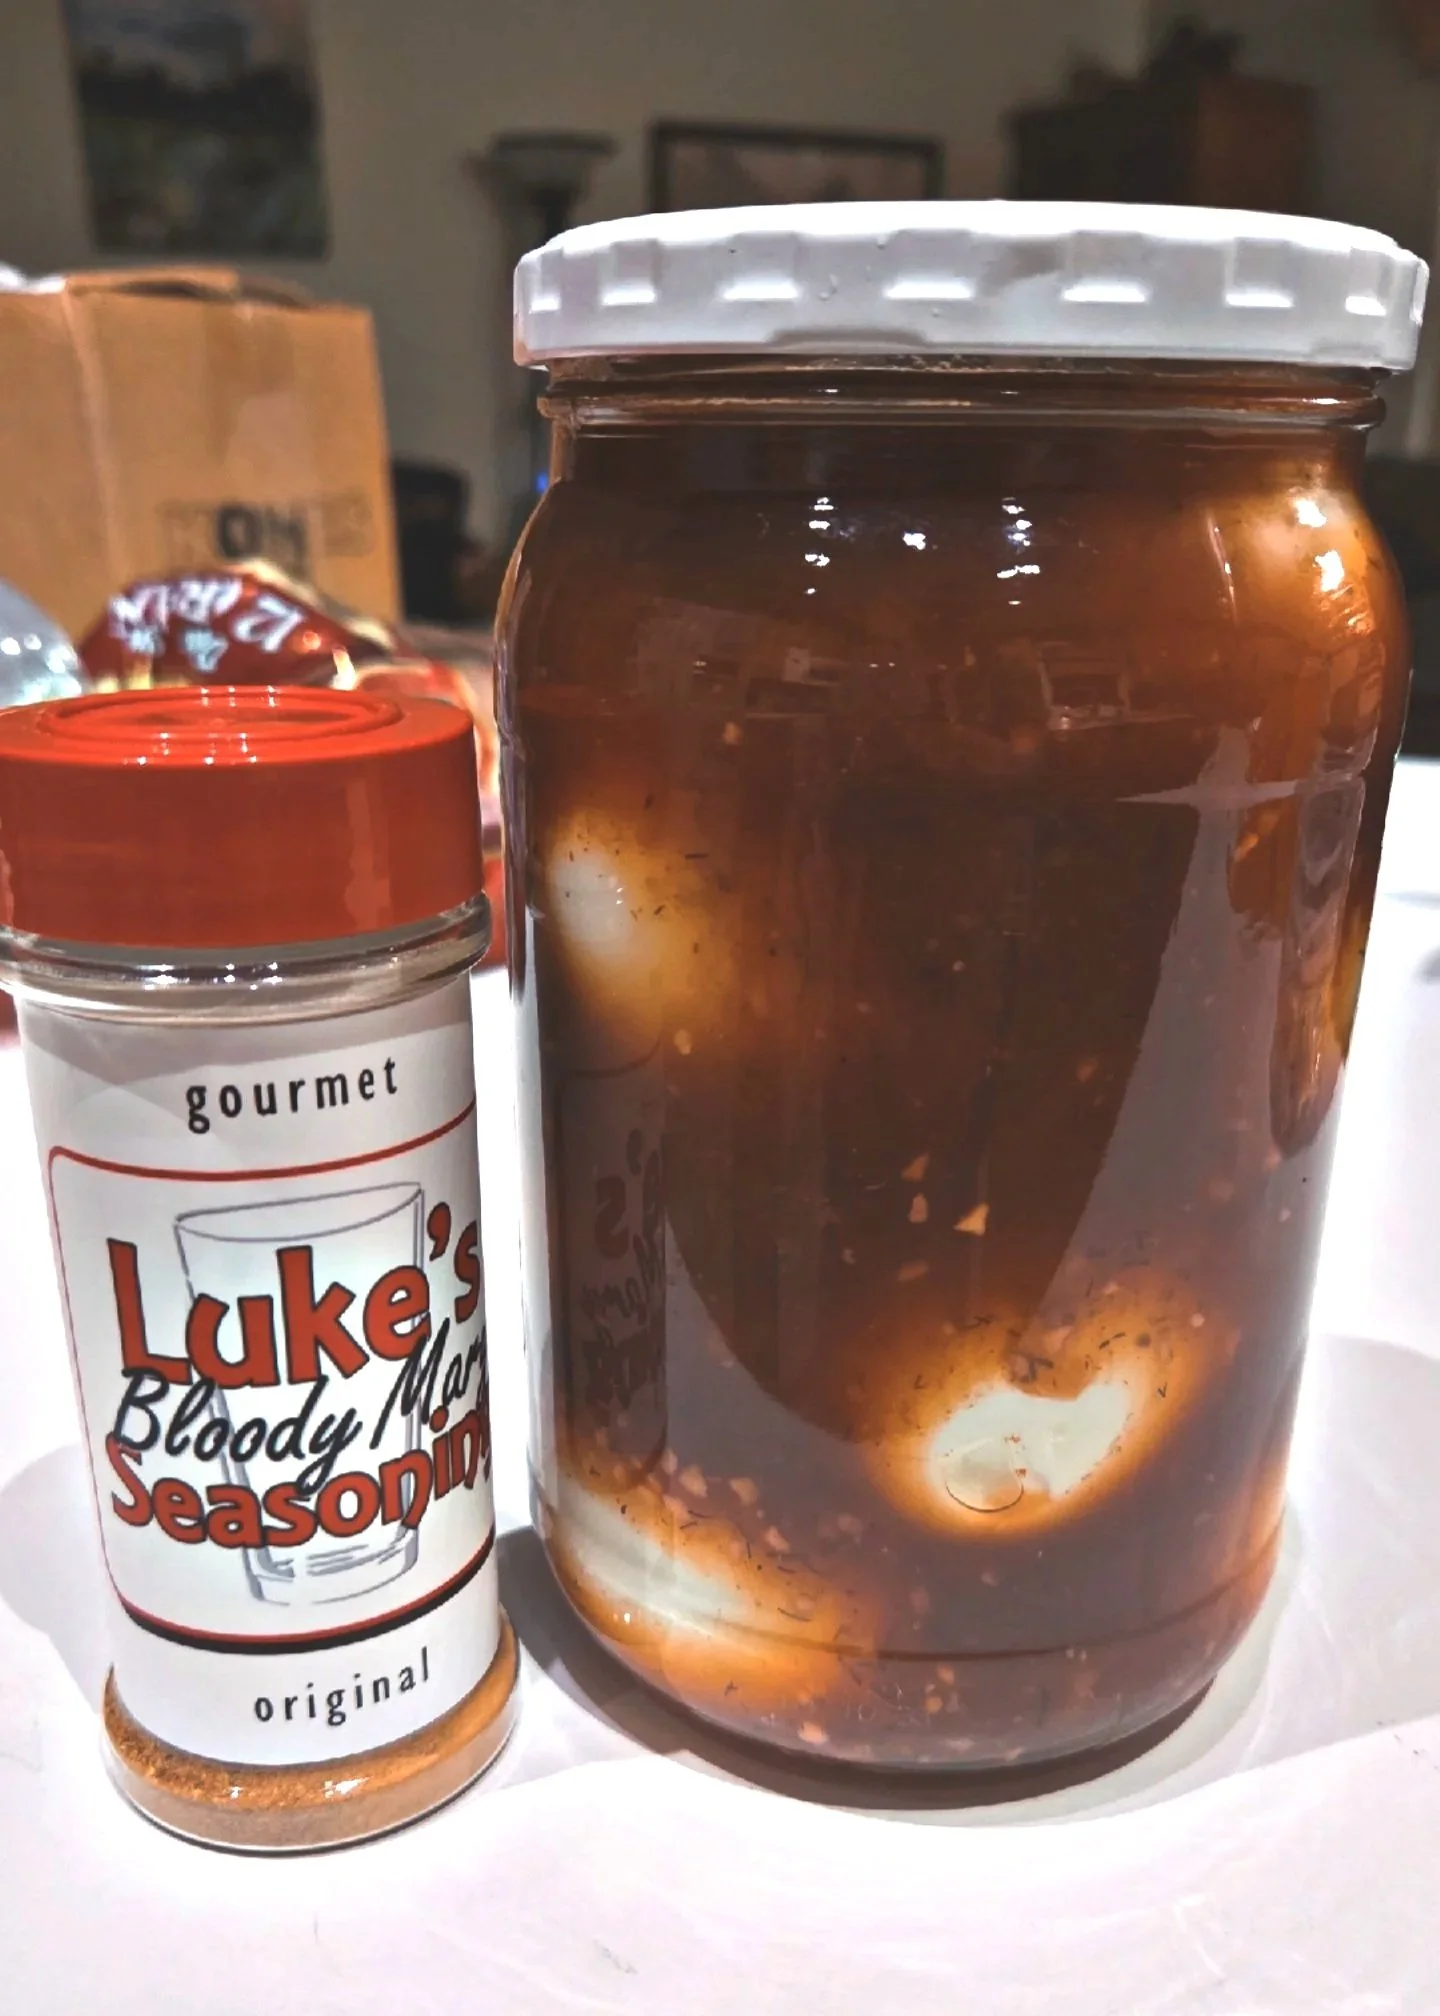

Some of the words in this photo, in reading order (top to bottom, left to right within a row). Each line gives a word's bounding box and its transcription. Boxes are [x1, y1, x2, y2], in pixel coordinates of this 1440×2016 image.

[186, 1057, 399, 1134] gourmet
[106, 1201, 482, 1390] Luke's
[114, 1368, 363, 1497] Bloody
[254, 1646, 430, 1727] original
